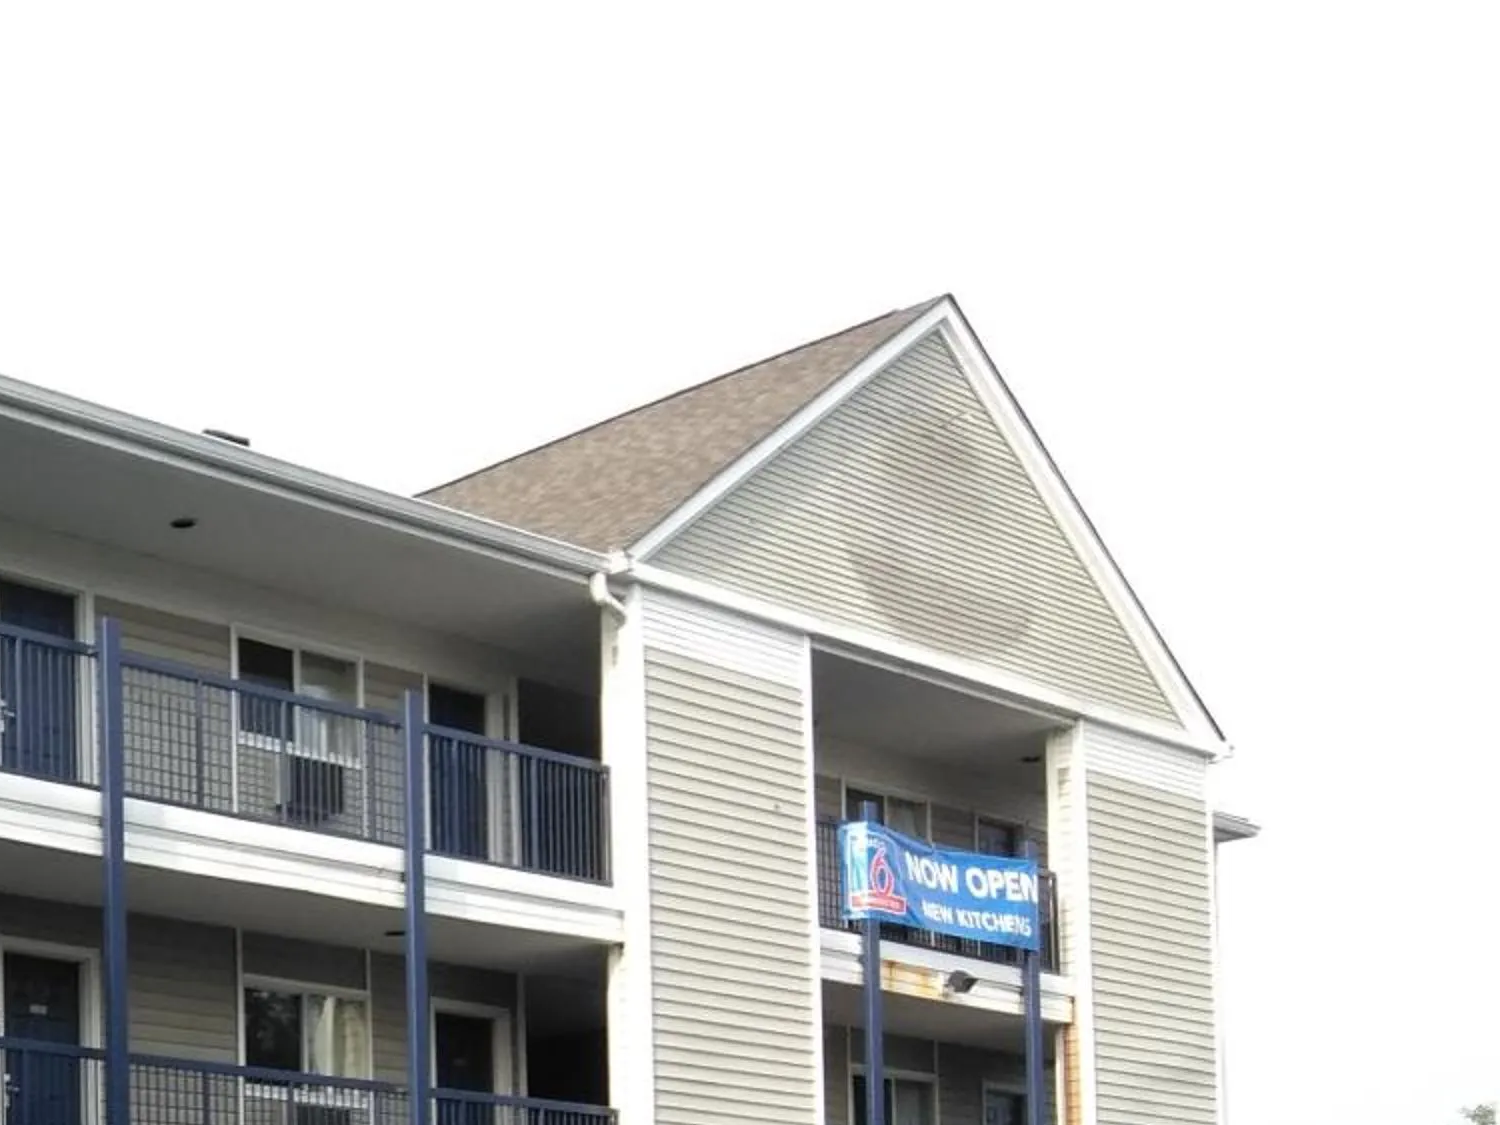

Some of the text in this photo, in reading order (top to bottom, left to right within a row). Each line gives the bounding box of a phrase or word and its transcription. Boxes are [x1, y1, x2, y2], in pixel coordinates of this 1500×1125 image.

[905, 852, 1038, 903] NOW OPEN
[921, 899, 954, 925] NEW
[956, 908, 1032, 938] KITCHENS
